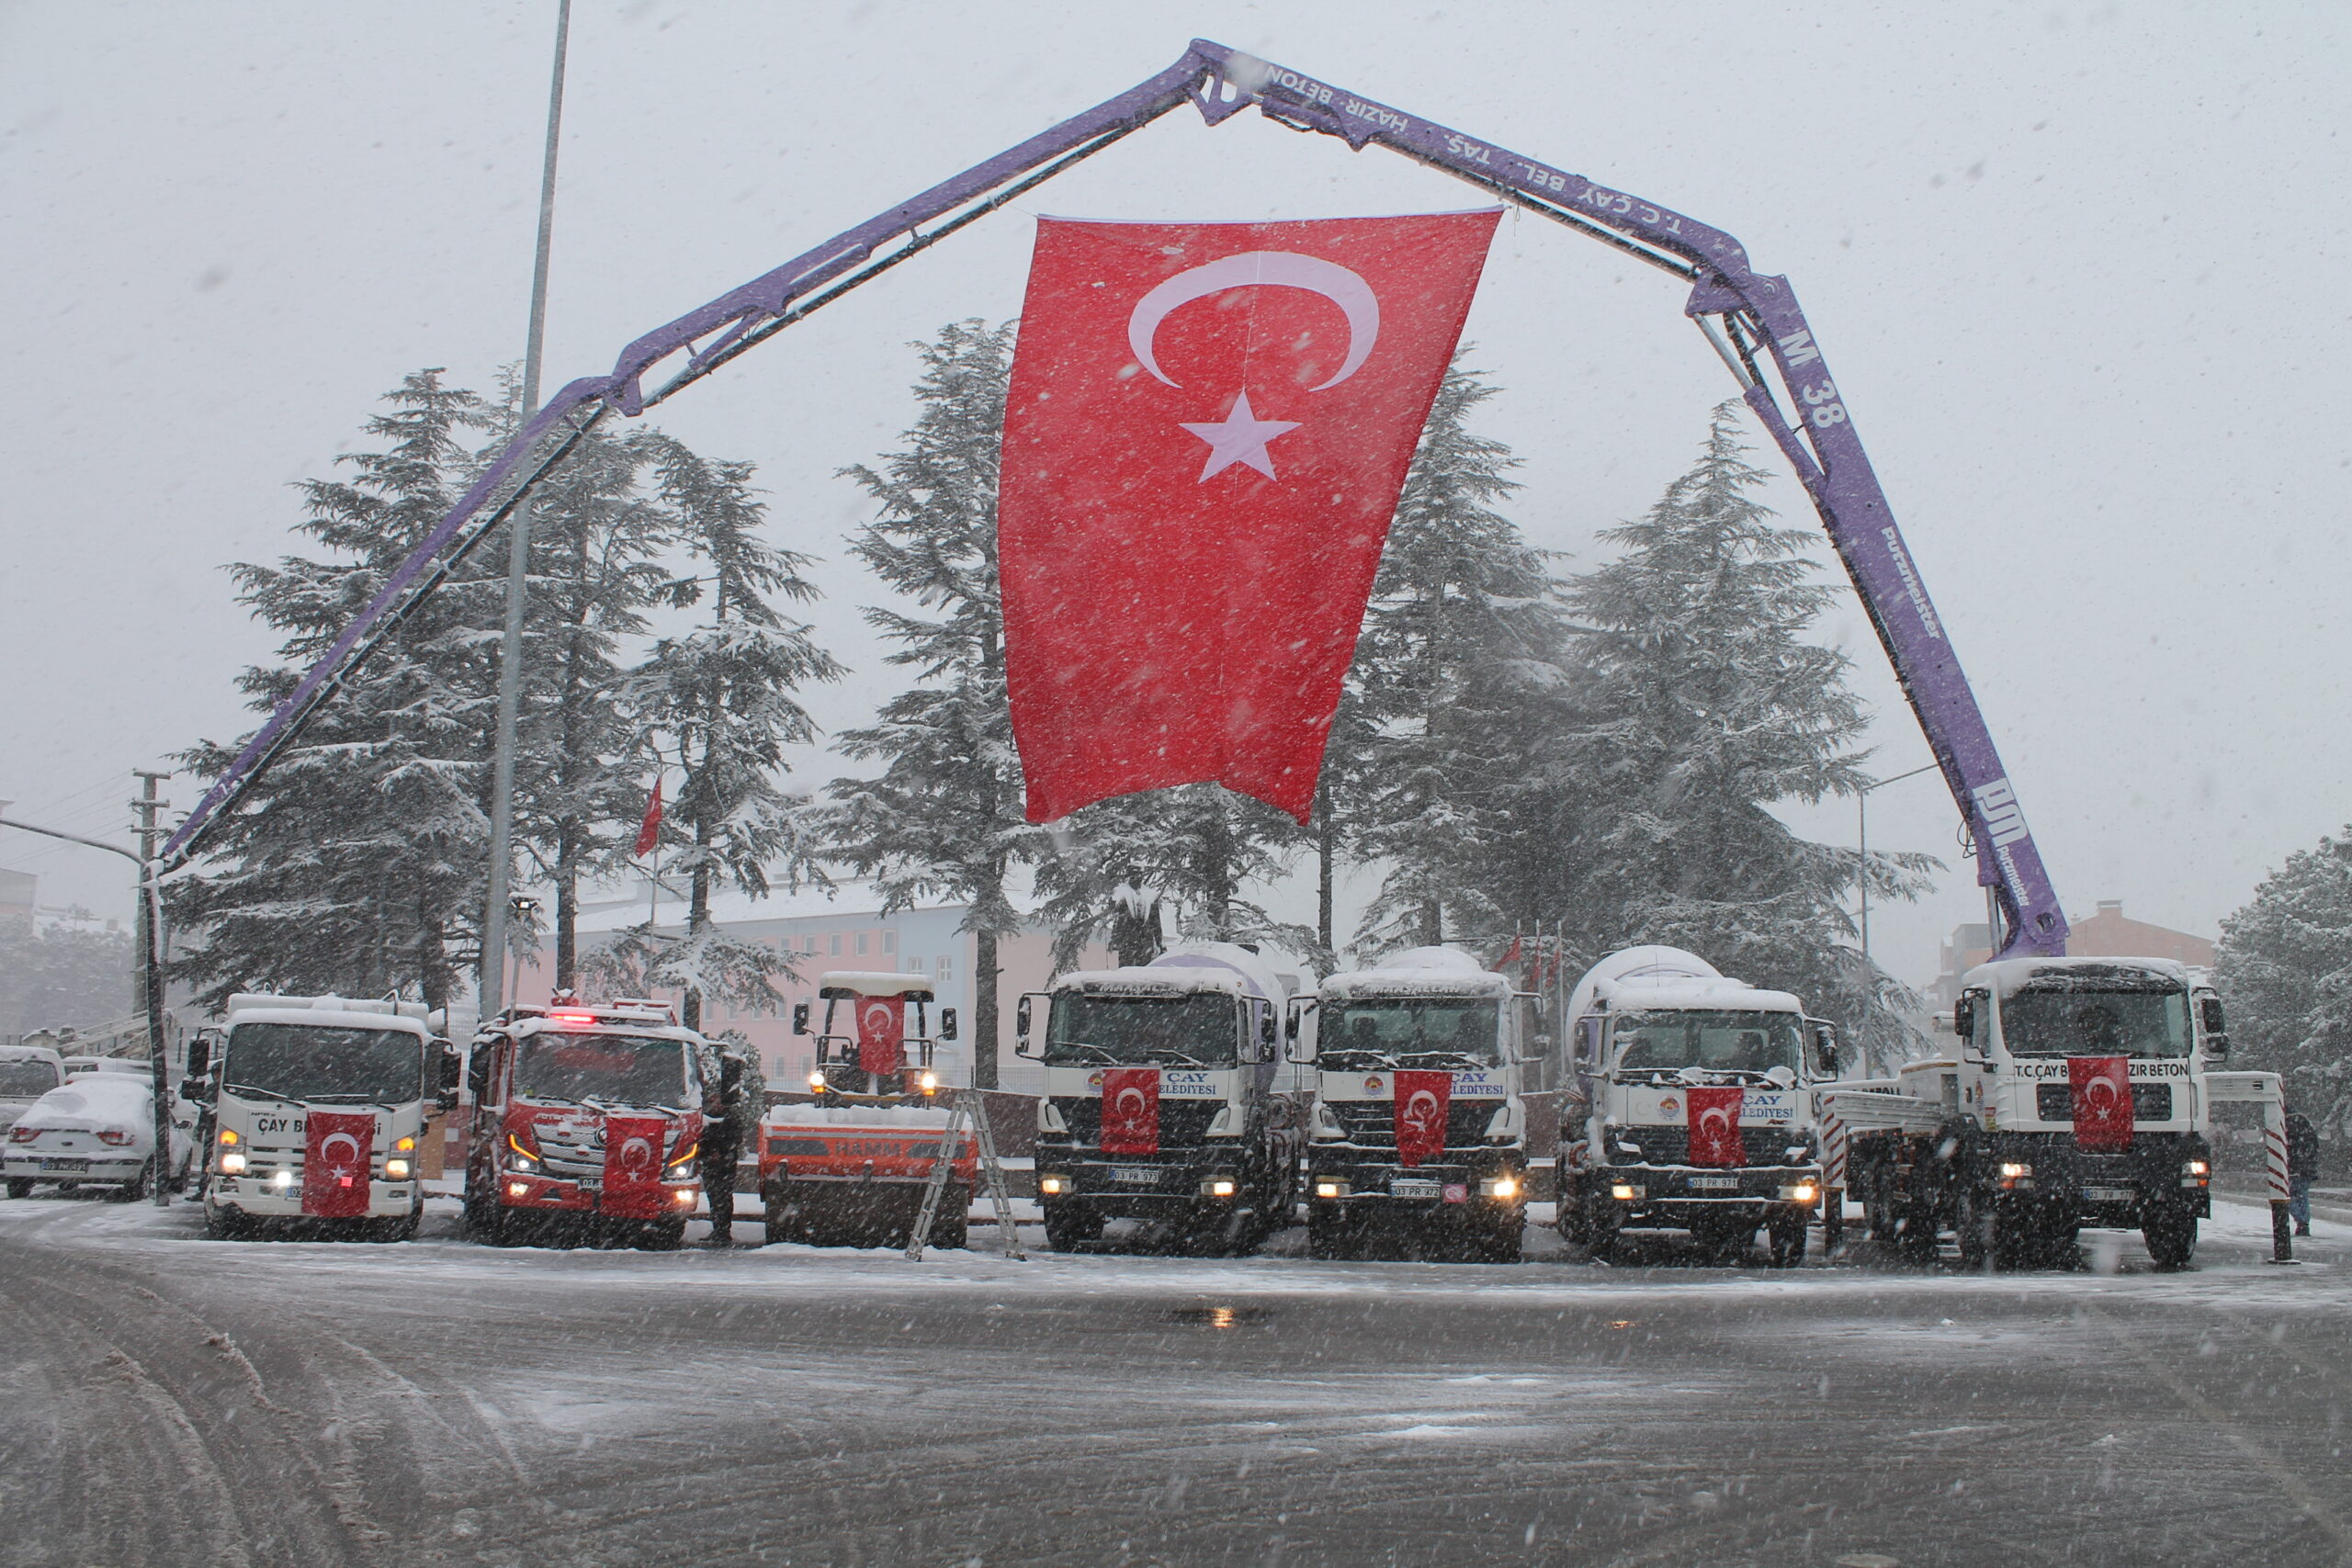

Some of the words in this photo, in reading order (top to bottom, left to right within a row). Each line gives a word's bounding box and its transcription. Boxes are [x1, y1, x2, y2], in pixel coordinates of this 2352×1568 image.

[1264, 65, 1333, 105] BETON
[1345, 98, 1409, 132] HAZIR
[1443, 134, 1491, 165] TAŞ.
[1517, 162, 1566, 192] BEL.
[1577, 187, 1633, 214] ÇAY
[1778, 330, 1820, 367] M
[1803, 379, 1846, 429] 38
[1881, 526, 1941, 639] Putzmeister
[1996, 844, 2030, 908] Putzmeister
[2035, 1065, 2061, 1081] ÇAY
[2128, 1064, 2148, 1077] ZIR
[2149, 1063, 2188, 1077] BETON
[1167, 1072, 1209, 1085] ÇAY
[1451, 1072, 1487, 1085] ÇAY
[1159, 1083, 1216, 1095] ELEDİYESİ
[1451, 1084, 1504, 1095] LEDİYESİ
[1742, 1095, 1781, 1108] ÇAY
[1740, 1107, 1794, 1119] LEDİYESİ
[258, 1118, 288, 1136] ÇAY
[1114, 1171, 1125, 1179] 03
[1128, 1172, 1139, 1181] PR
[1692, 1179, 1702, 1188] 03
[1396, 1187, 1406, 1196] 03
[1408, 1188, 1421, 1196] PR
